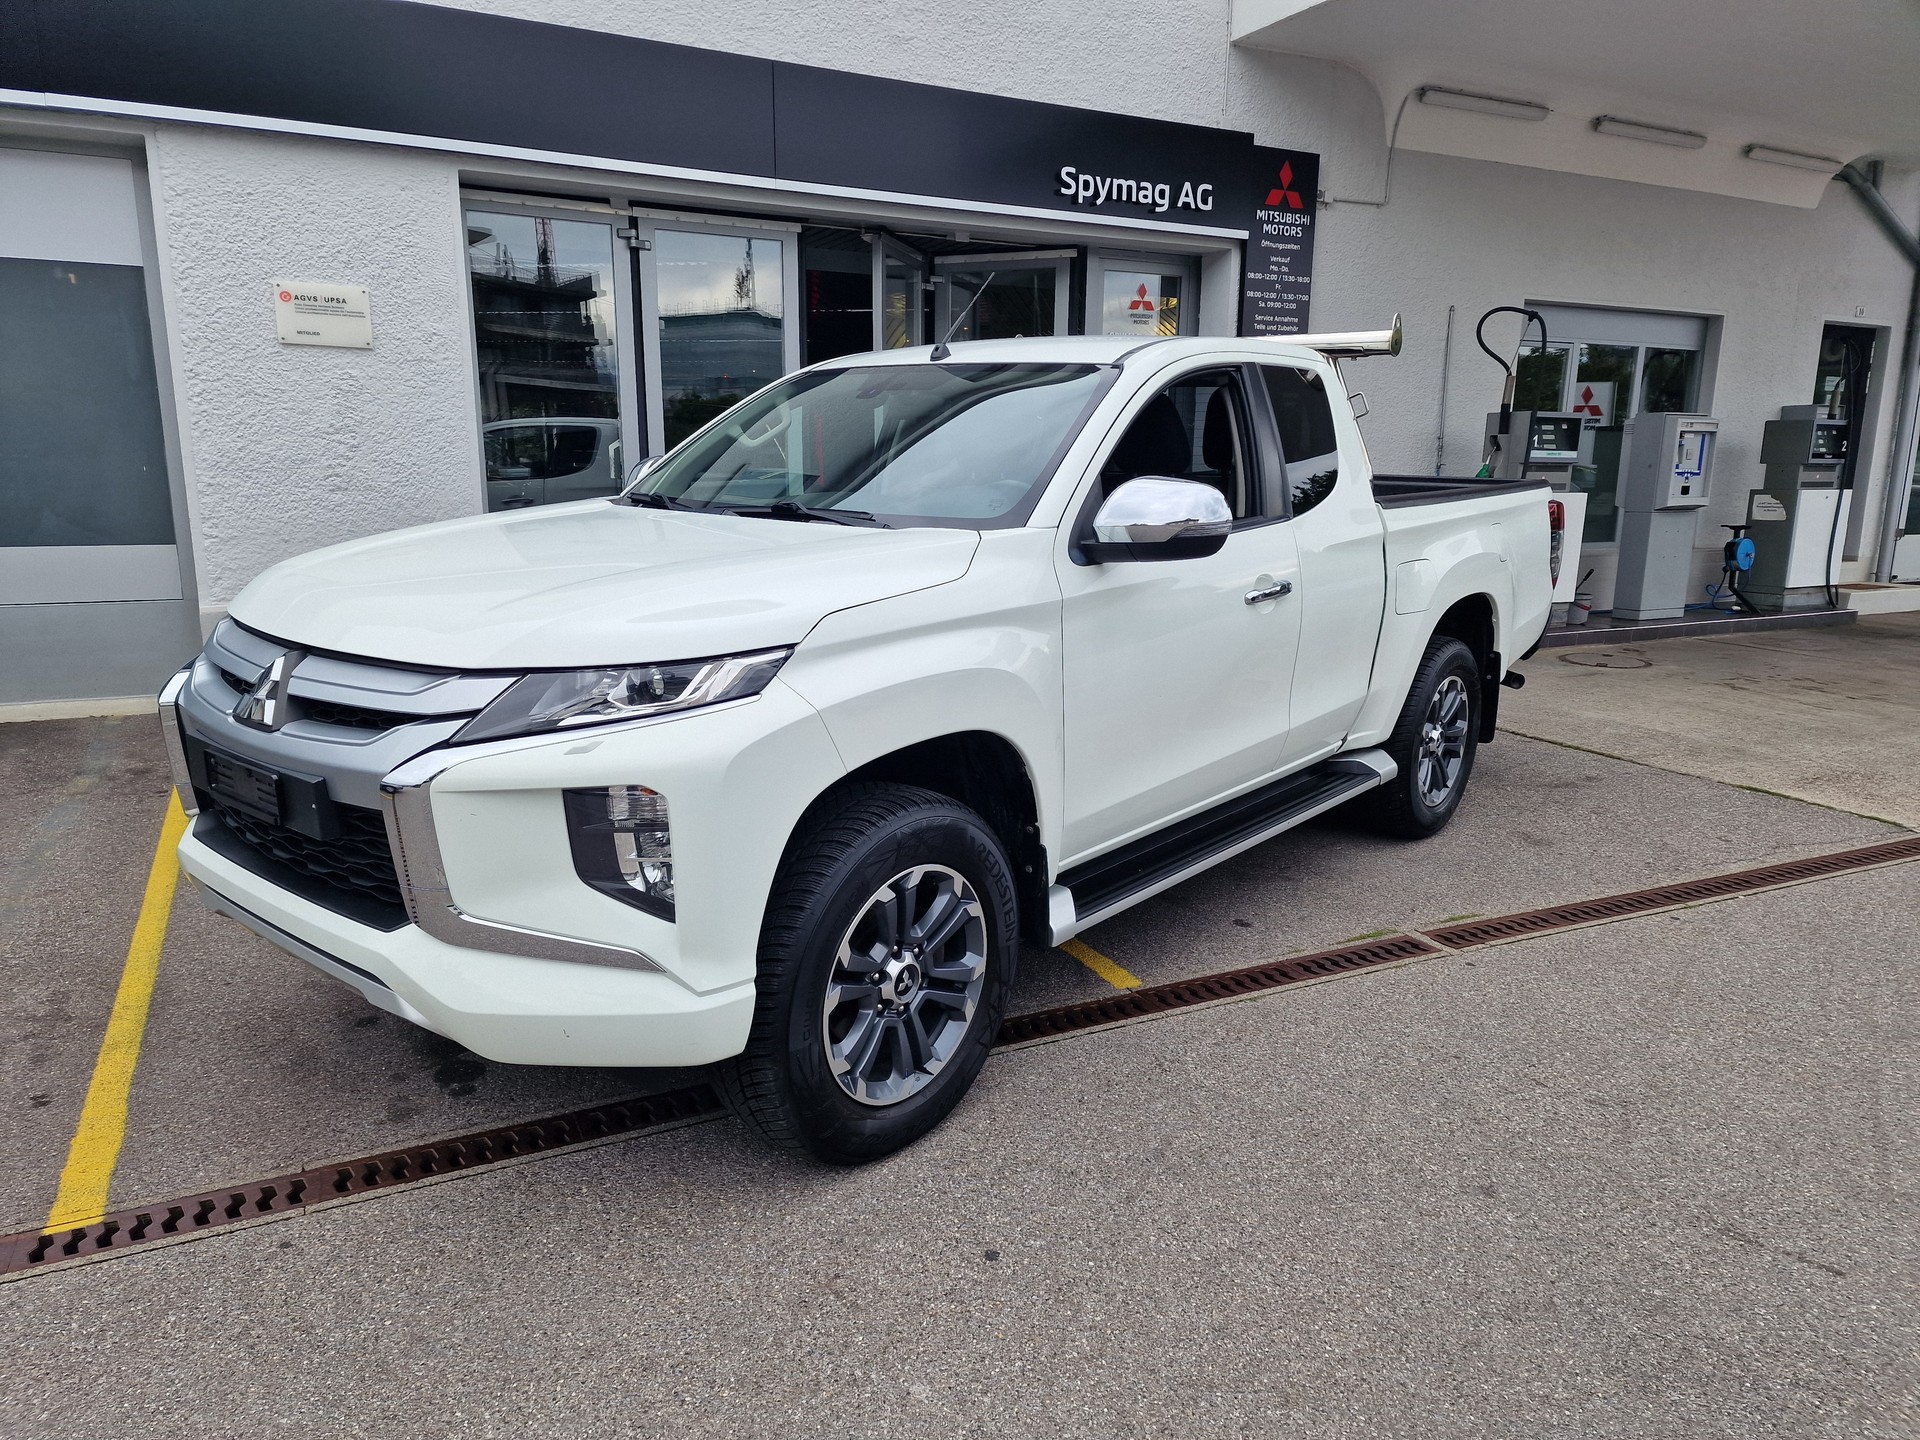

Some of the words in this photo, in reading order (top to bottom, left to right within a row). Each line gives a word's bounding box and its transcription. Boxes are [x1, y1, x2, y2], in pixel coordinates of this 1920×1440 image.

[1060, 166, 1170, 212] Spymag
[1177, 181, 1213, 211] AG
[1256, 209, 1310, 225] MITSUBISHI
[1263, 223, 1303, 237] MOTORS
[1260, 239, 1301, 251] Öffnungszeiten
[1247, 272, 1278, 281] 08:00-12:00
[294, 294, 318, 302] AGVS
[323, 296, 347, 304] UPSA
[1246, 290, 1277, 299] 08:00-12:00
[1258, 300, 1266, 308] Sa.
[1266, 301, 1297, 309] 09:00-12:00
[1254, 314, 1274, 322] Service
[1273, 315, 1299, 323] Annahme
[1277, 324, 1299, 332] Zubehör
[1533, 434, 1539, 447] 1
[1841, 440, 1848, 452] 2
